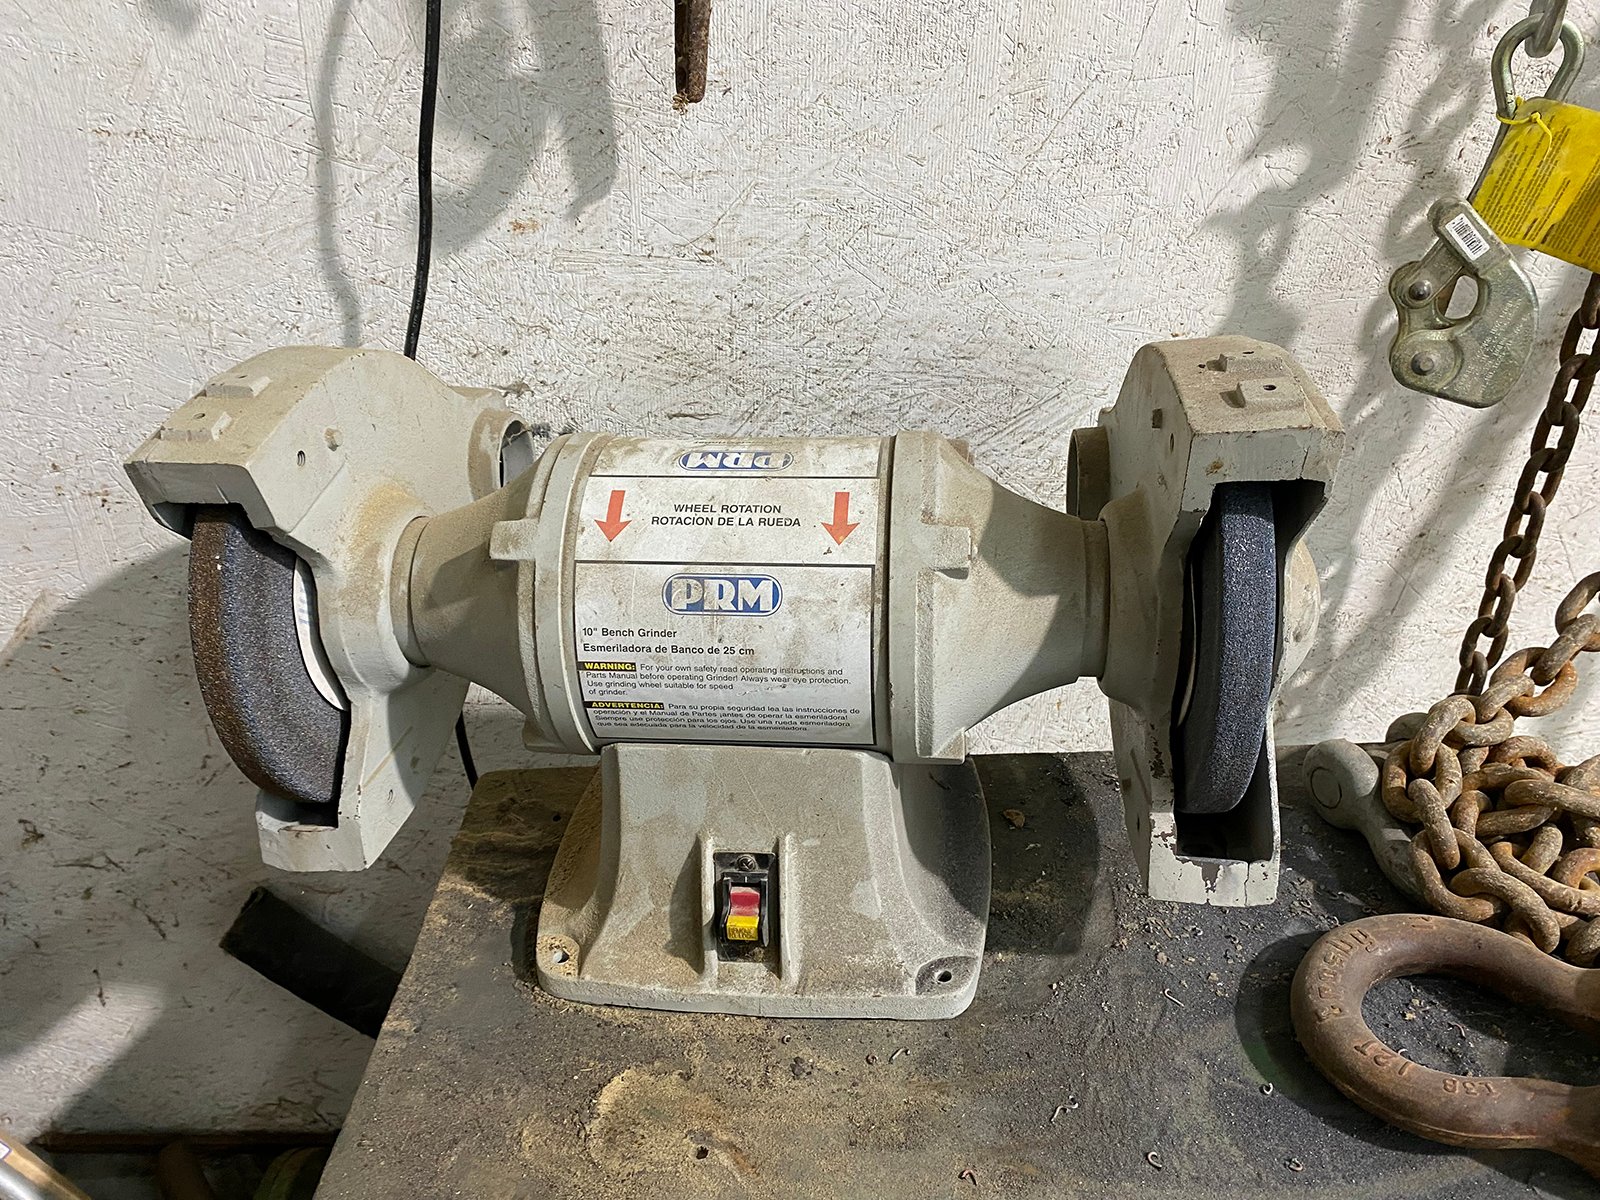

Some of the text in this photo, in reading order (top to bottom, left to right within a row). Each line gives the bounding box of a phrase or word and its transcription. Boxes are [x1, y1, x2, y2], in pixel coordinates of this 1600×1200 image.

[686, 452, 784, 469] PRM
[674, 504, 782, 514] WHEEL ROTATION
[718, 517, 734, 526] DE
[738, 518, 754, 526] LA
[758, 518, 801, 526] RUEDA
[672, 578, 773, 610] PRM
[582, 628, 677, 638] 10" Bench Grinder
[583, 643, 652, 653] Esmeriladora
[655, 644, 668, 654] de
[671, 645, 704, 654] Banco
[708, 645, 720, 654] de
[723, 646, 736, 655] 25
[584, 662, 636, 670] WARNING:
[694, 664, 718, 674] safety
[740, 667, 778, 675] operating
[780, 666, 825, 675] instructions
[740, 675, 768, 683] Always
[810, 676, 851, 684] protection.
[606, 681, 636, 689] grinding
